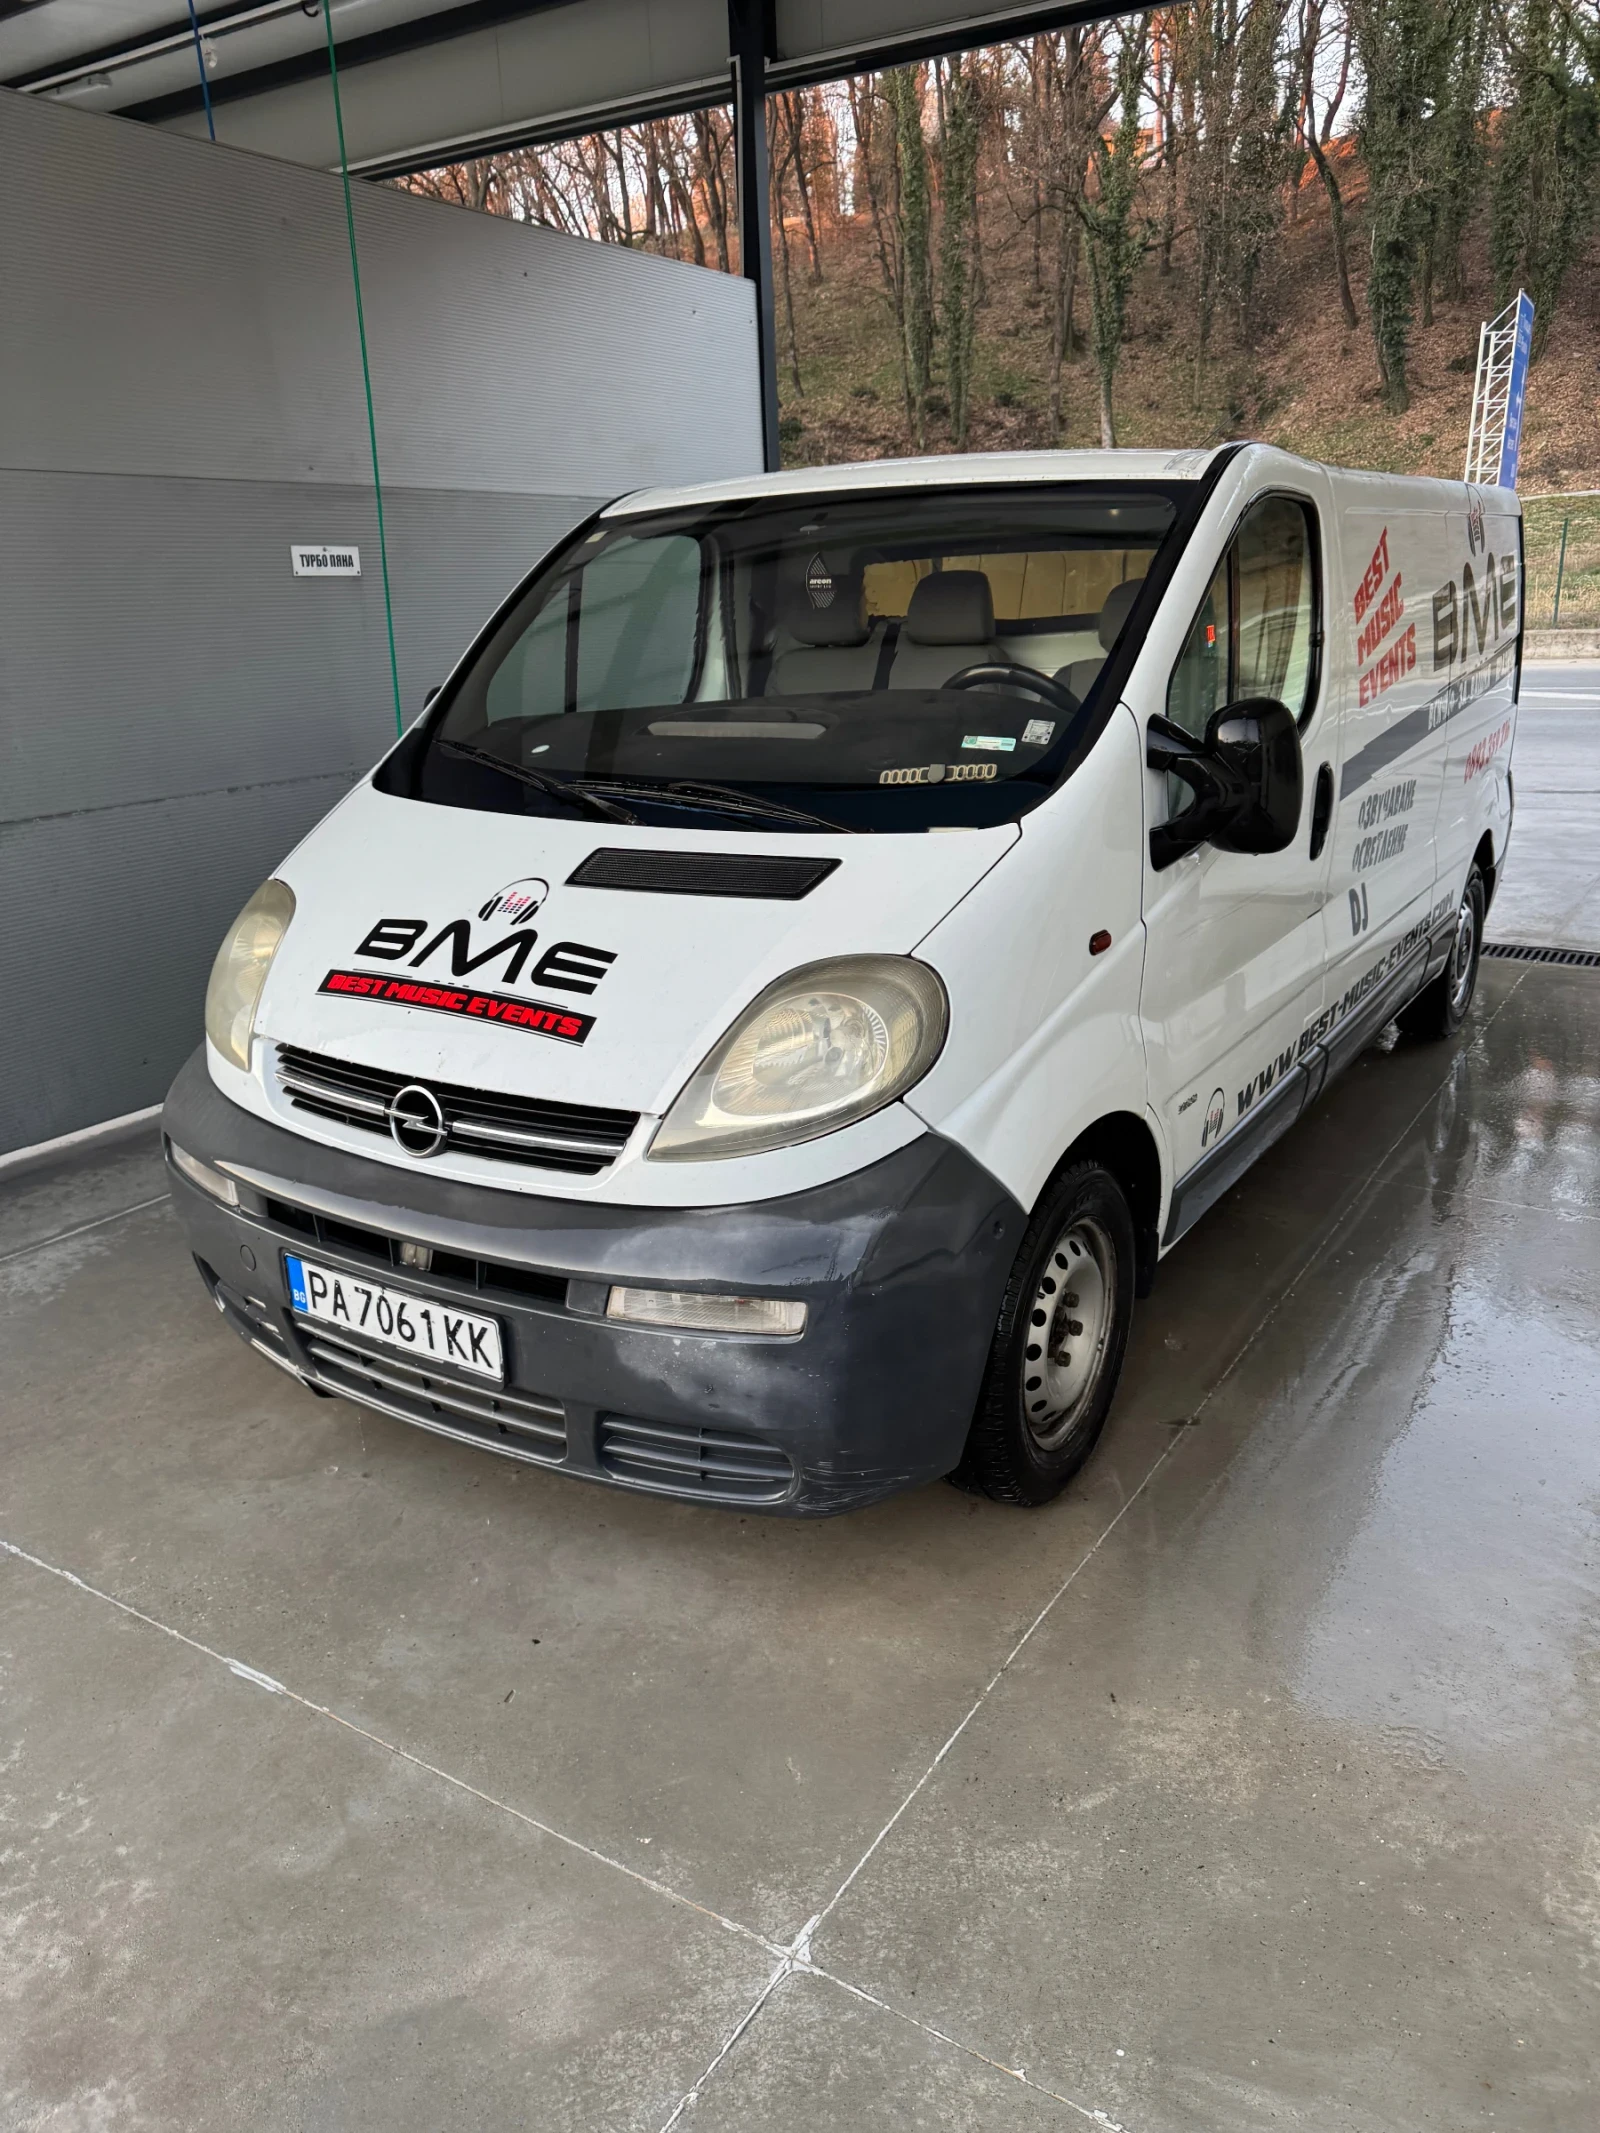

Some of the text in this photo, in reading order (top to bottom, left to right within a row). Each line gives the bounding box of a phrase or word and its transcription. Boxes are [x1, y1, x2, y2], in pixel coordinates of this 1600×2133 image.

[299, 554, 354, 568] ТУРБО ПЯНА
[1354, 526, 1390, 624] BEST
[1357, 571, 1404, 667] MUSIC
[1432, 552, 1516, 672] BME
[1359, 622, 1416, 708] EVENTS
[1349, 882, 1368, 936] DJ
[354, 919, 619, 995] BME
[327, 974, 583, 1037] BEST MUSIC EVENTS
[1237, 889, 1455, 1117] WWW.BEST-MUSIC-EVENTS.COM
[293, 1288, 307, 1304] BG
